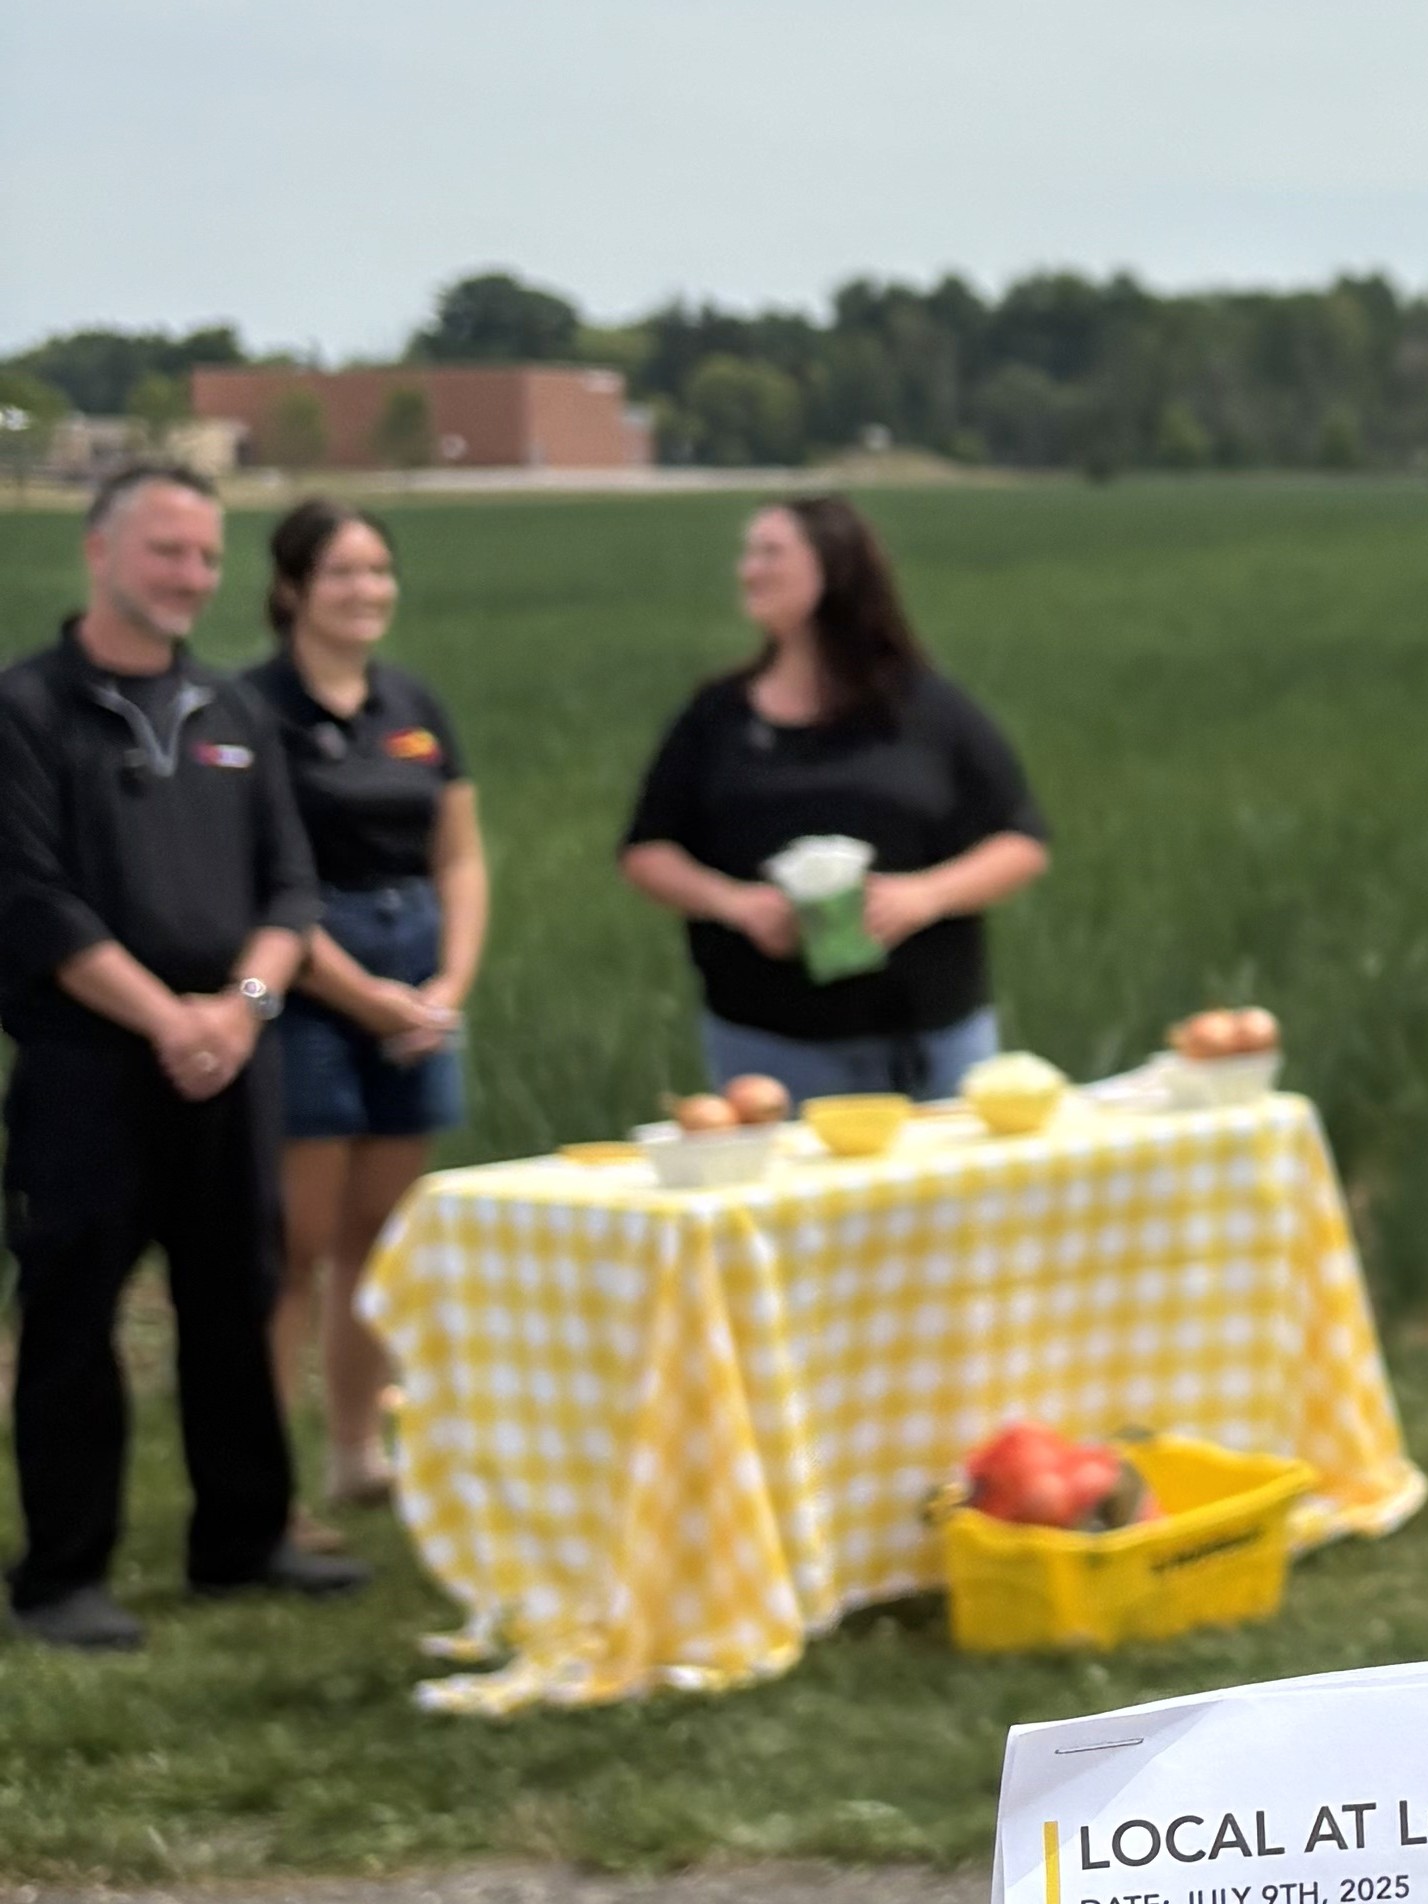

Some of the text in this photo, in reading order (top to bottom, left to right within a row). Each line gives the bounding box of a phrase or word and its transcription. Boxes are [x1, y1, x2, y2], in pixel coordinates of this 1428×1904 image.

[1080, 1810, 1286, 1871] LOCAL
[1303, 1802, 1377, 1854] AT
[1340, 1874, 1410, 1903] 2025
